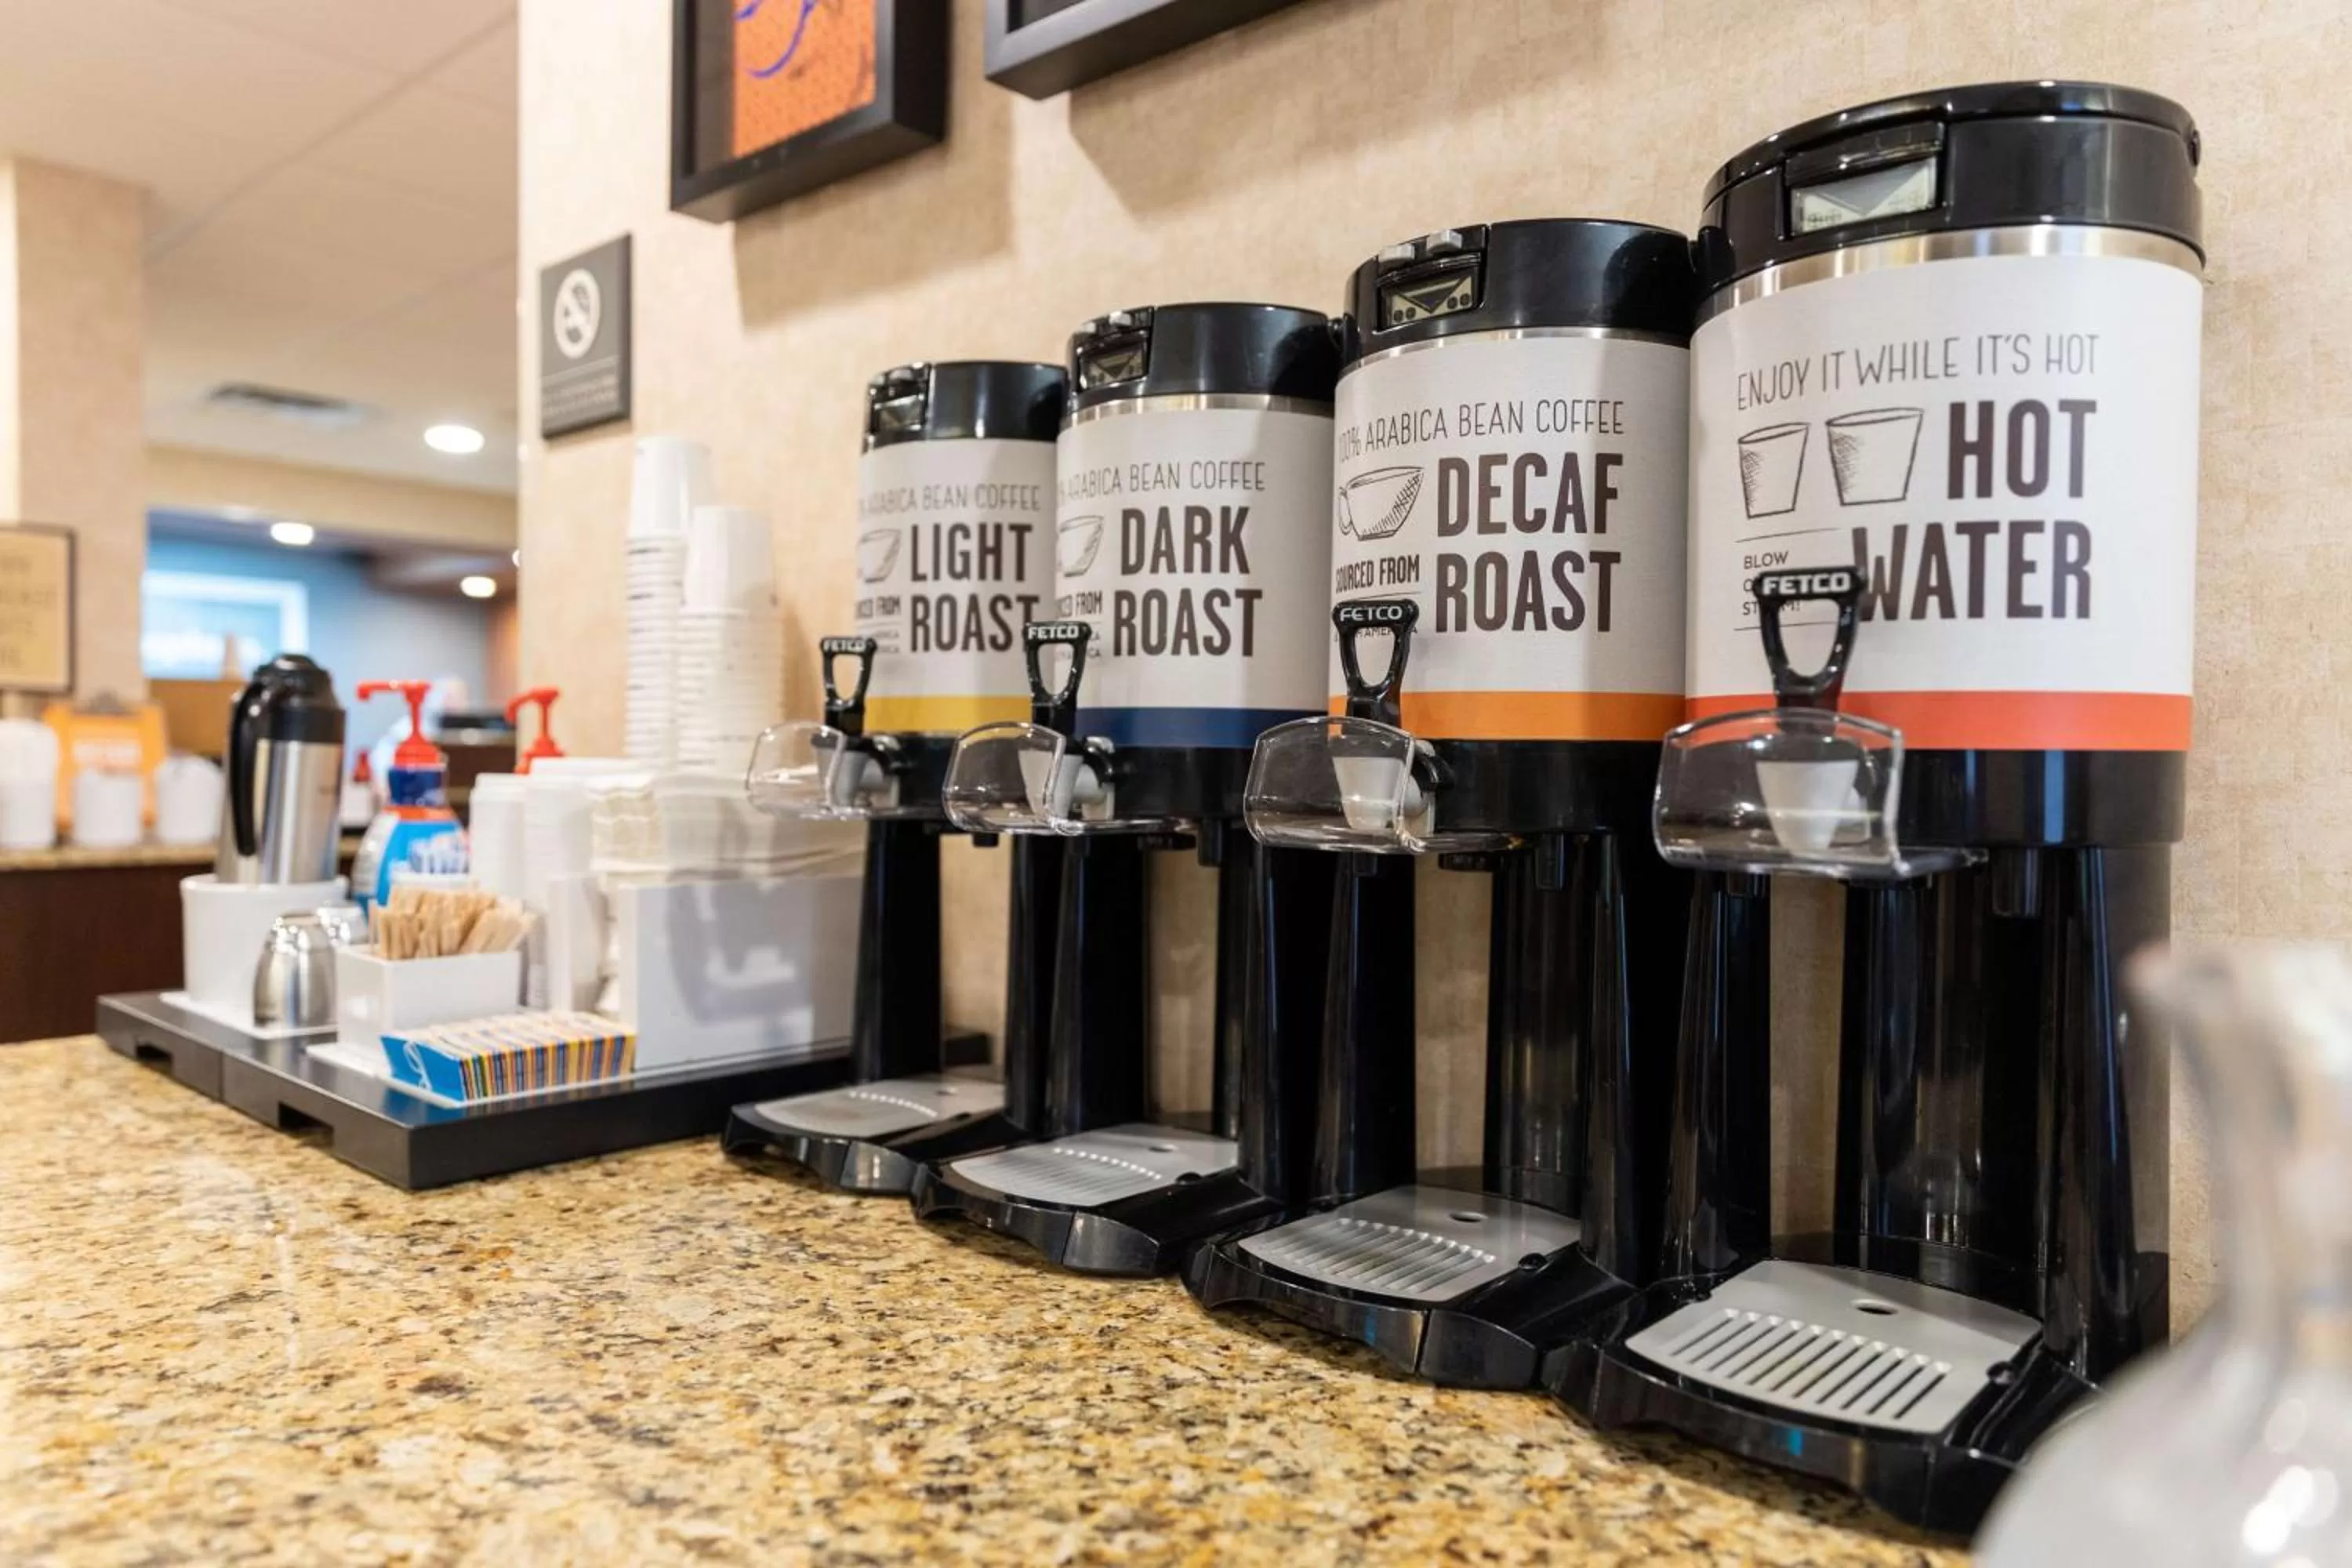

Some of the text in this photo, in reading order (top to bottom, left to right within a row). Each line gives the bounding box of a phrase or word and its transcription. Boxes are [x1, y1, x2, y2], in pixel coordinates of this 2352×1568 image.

[1737, 332, 2100, 411] ENJOY IT WHILE IT'S HOT
[1364, 407, 1449, 452] ARABICA
[1458, 401, 1524, 437] BEAN
[1535, 398, 1625, 435] COFFEE
[1947, 398, 2097, 500] HOT
[921, 483, 967, 511] BEAN
[975, 482, 1041, 512] COFFEE
[1129, 461, 1181, 493] BEAN
[1190, 460, 1267, 492] COFFEE
[1437, 452, 1624, 538] DECAF
[910, 522, 1033, 583] LIGHT
[1120, 506, 1251, 576] DARK
[1743, 550, 1789, 570] BLOW
[1379, 554, 1420, 586] FROM
[1436, 550, 1622, 633] ROAST
[1762, 572, 1851, 597] FETCO
[1851, 520, 2092, 622] WATER
[910, 593, 1040, 654] ROAST
[1027, 625, 1080, 640] FETCO
[1112, 588, 1264, 658] ROAST
[1340, 605, 1403, 622] FETCO
[1742, 598, 1802, 615] STM!
